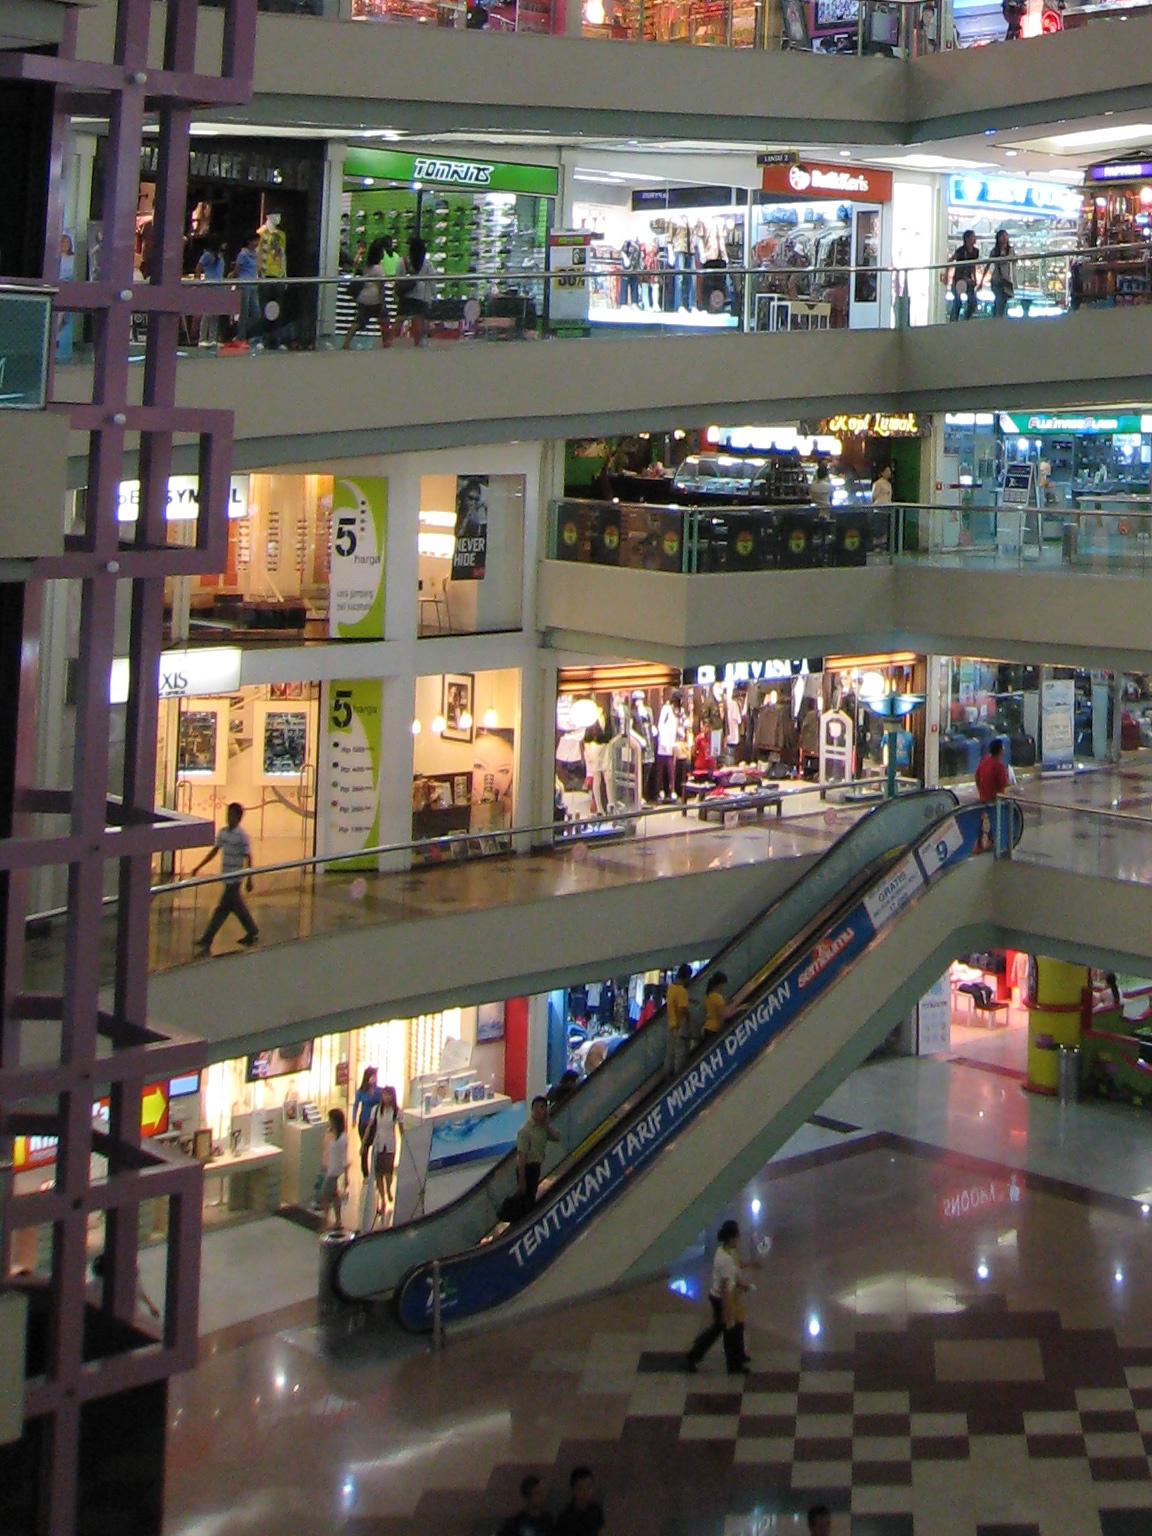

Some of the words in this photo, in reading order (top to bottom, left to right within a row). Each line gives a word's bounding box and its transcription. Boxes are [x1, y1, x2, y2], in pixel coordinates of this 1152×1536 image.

[874, 412, 918, 437] Luwak
[335, 518, 357, 557] 5
[456, 538, 485, 552] NEVER
[354, 554, 381, 566] harga
[454, 553, 476, 566] HIDE
[332, 690, 353, 728] 5
[935, 840, 949, 862] 9
[509, 1159, 611, 1267] TENTUKAN
[612, 1108, 664, 1166] TARIF
[666, 1051, 723, 1116] MURAH
[725, 981, 791, 1057] DENGAN
